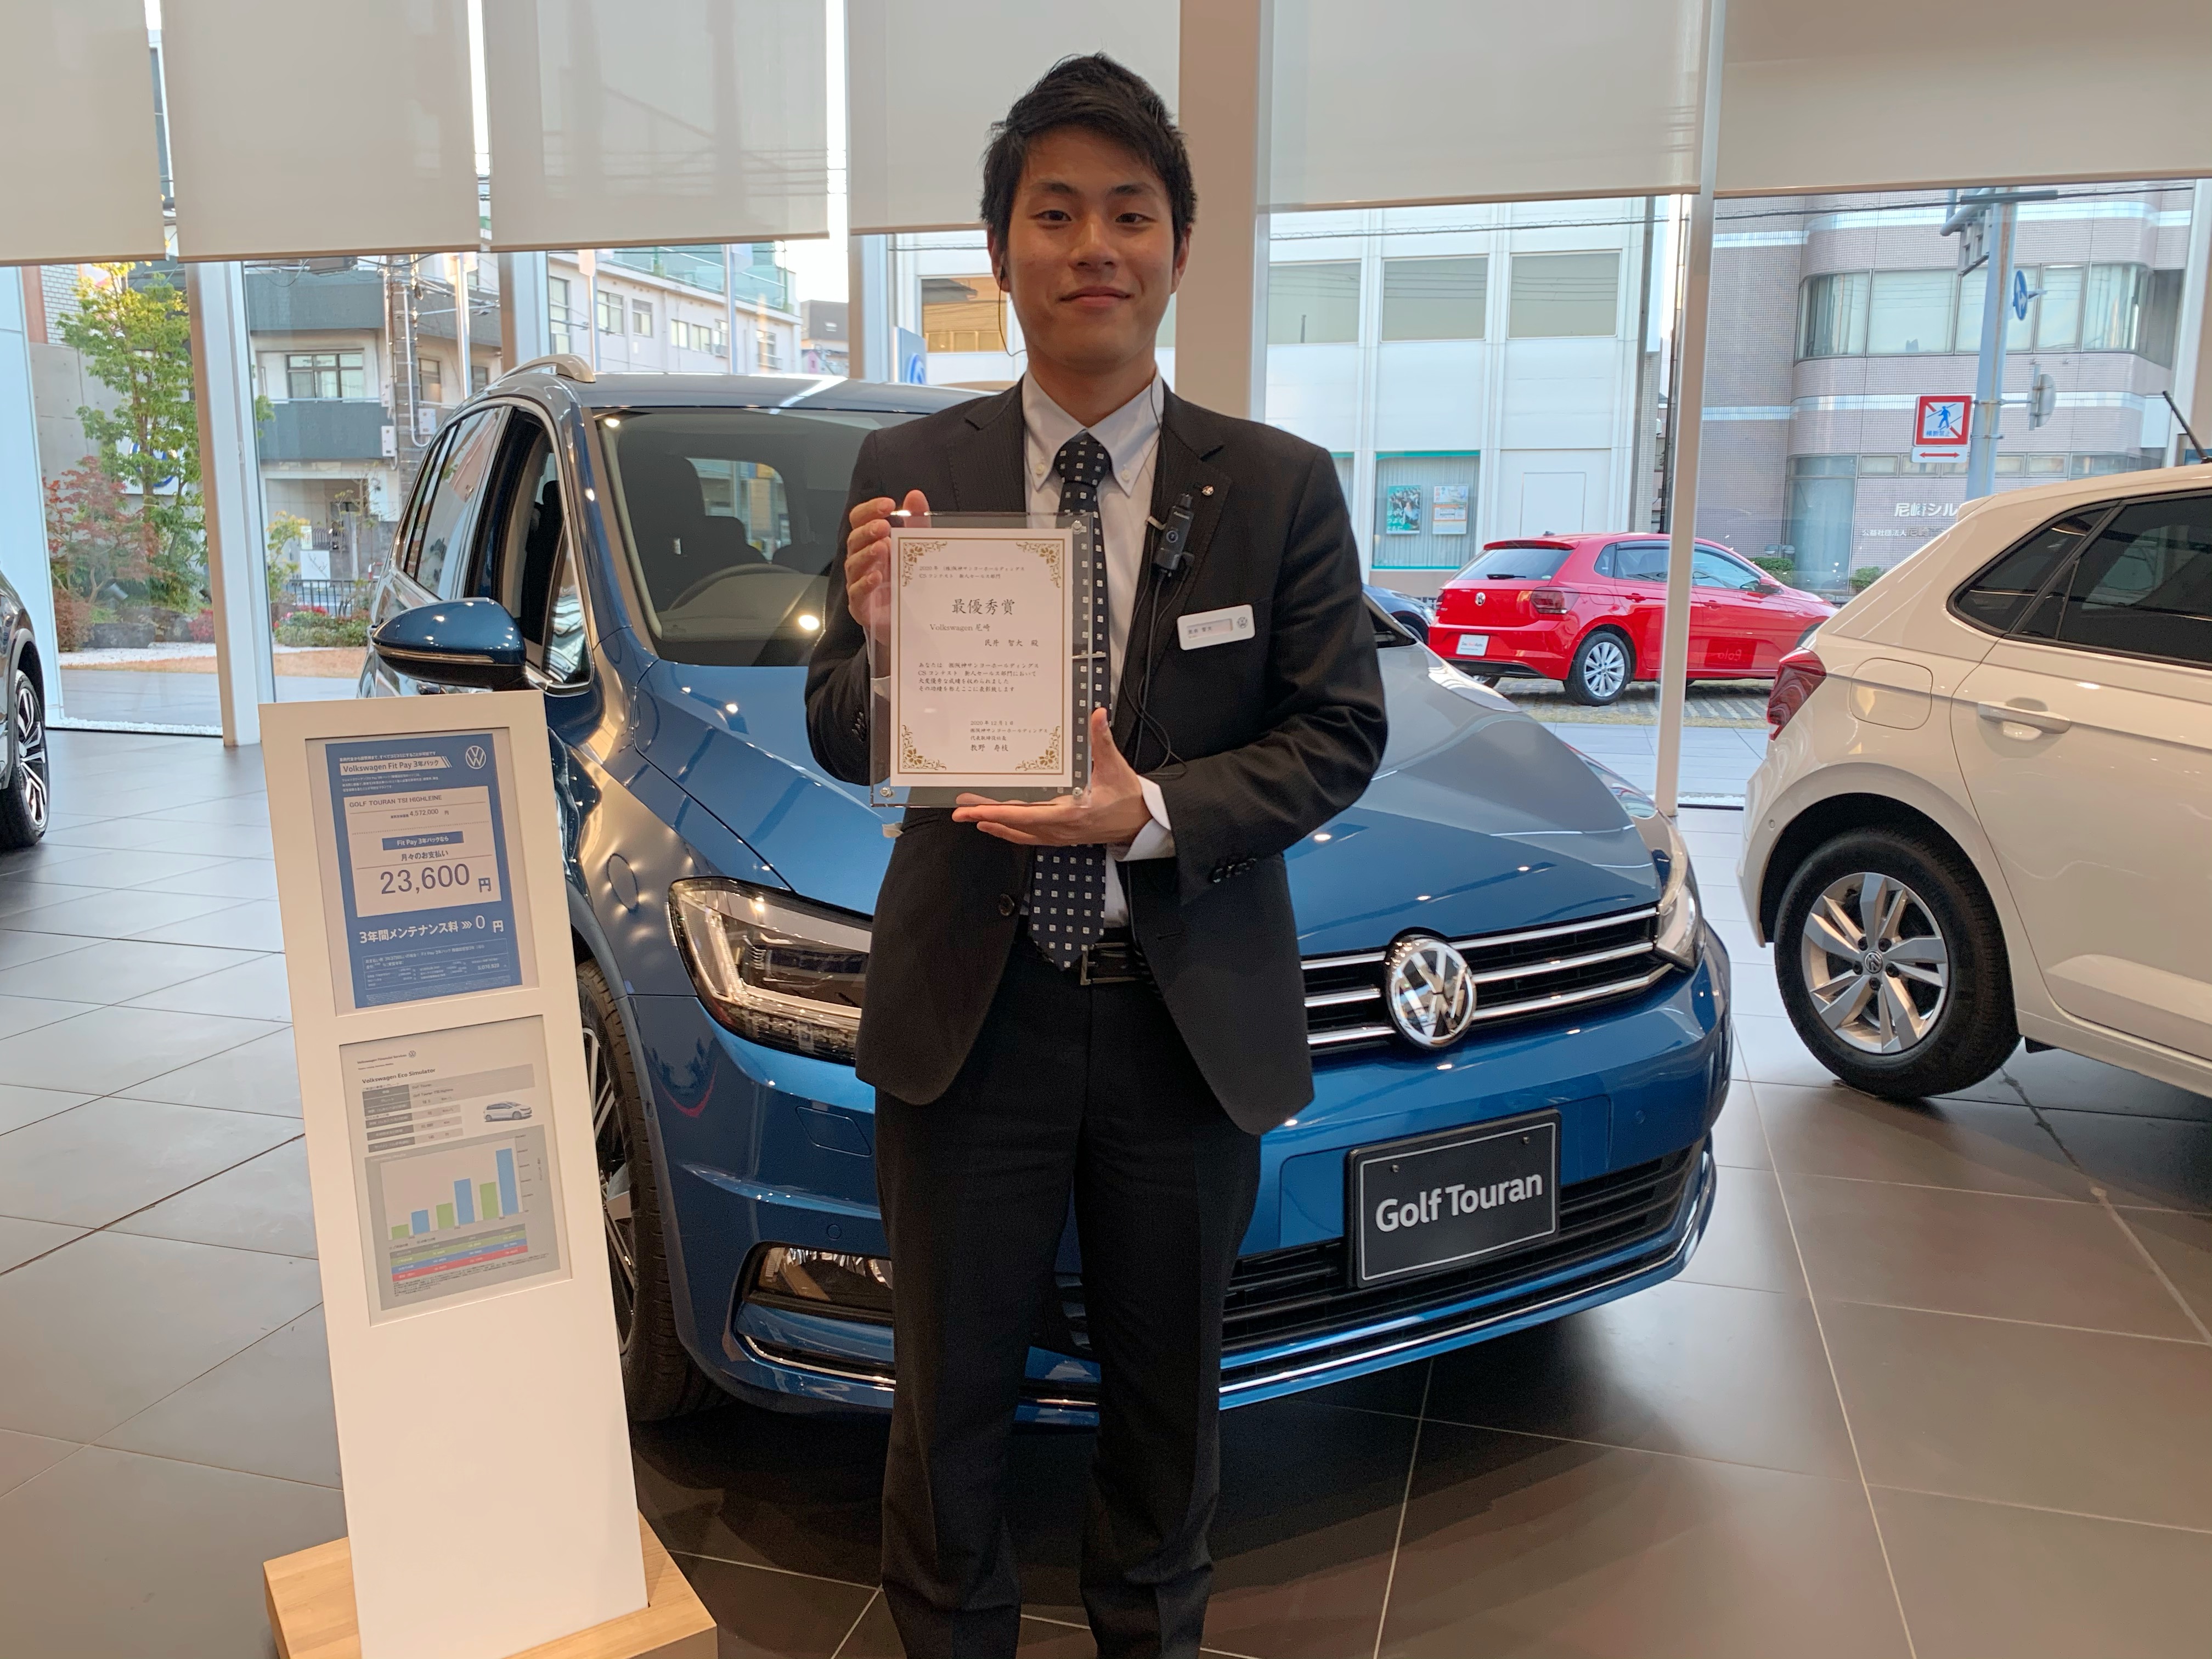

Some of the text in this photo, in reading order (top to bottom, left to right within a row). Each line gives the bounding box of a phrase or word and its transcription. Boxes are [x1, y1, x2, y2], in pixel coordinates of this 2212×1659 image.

[1894, 502, 1958, 517] 尼崎シル
[952, 598, 1015, 615] 最優秀賞
[929, 623, 990, 632] Volkswagen 尼崎
[343, 764, 387, 772] Volkswagen
[399, 761, 412, 770] Pay
[401, 850, 448, 861] 月々のお支払い
[380, 863, 492, 894] 23,600 円
[359, 915, 504, 944] 3年間メンテナンス料 0 円
[362, 1074, 397, 1084] Volkswagen
[409, 1068, 436, 1076] Simulator
[1375, 1173, 1543, 1233] Golf Touran
